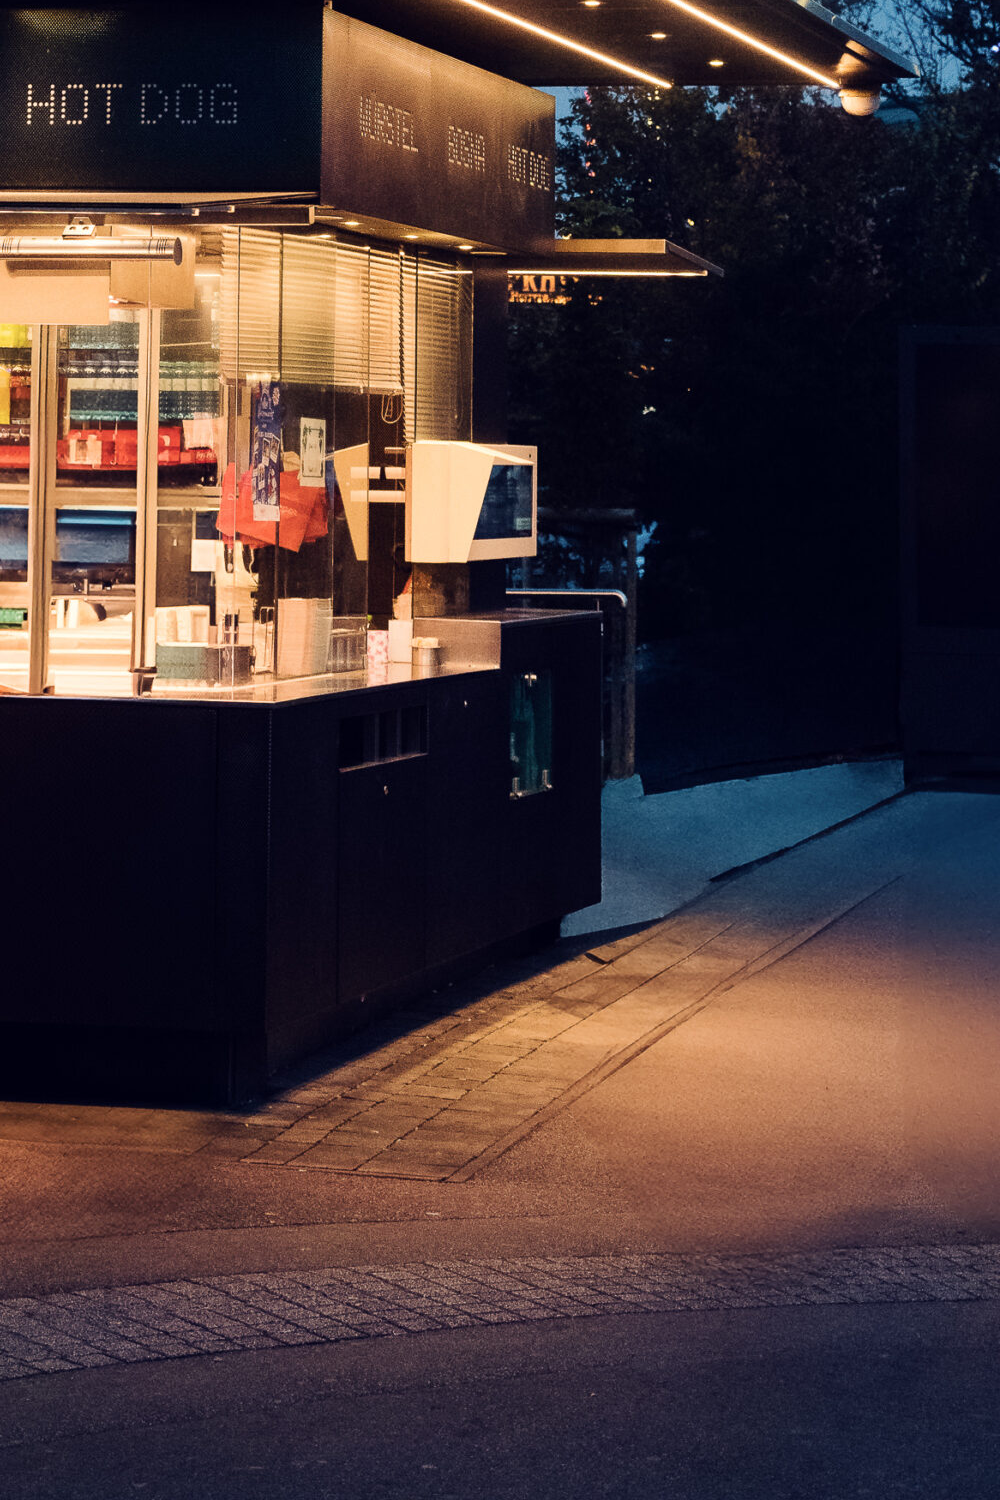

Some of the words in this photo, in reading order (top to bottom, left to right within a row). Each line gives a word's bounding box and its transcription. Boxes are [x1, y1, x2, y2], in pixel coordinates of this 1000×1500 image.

[26, 83, 123, 125] HOT
[140, 83, 239, 125] DOG
[448, 125, 485, 172] BOSNA
